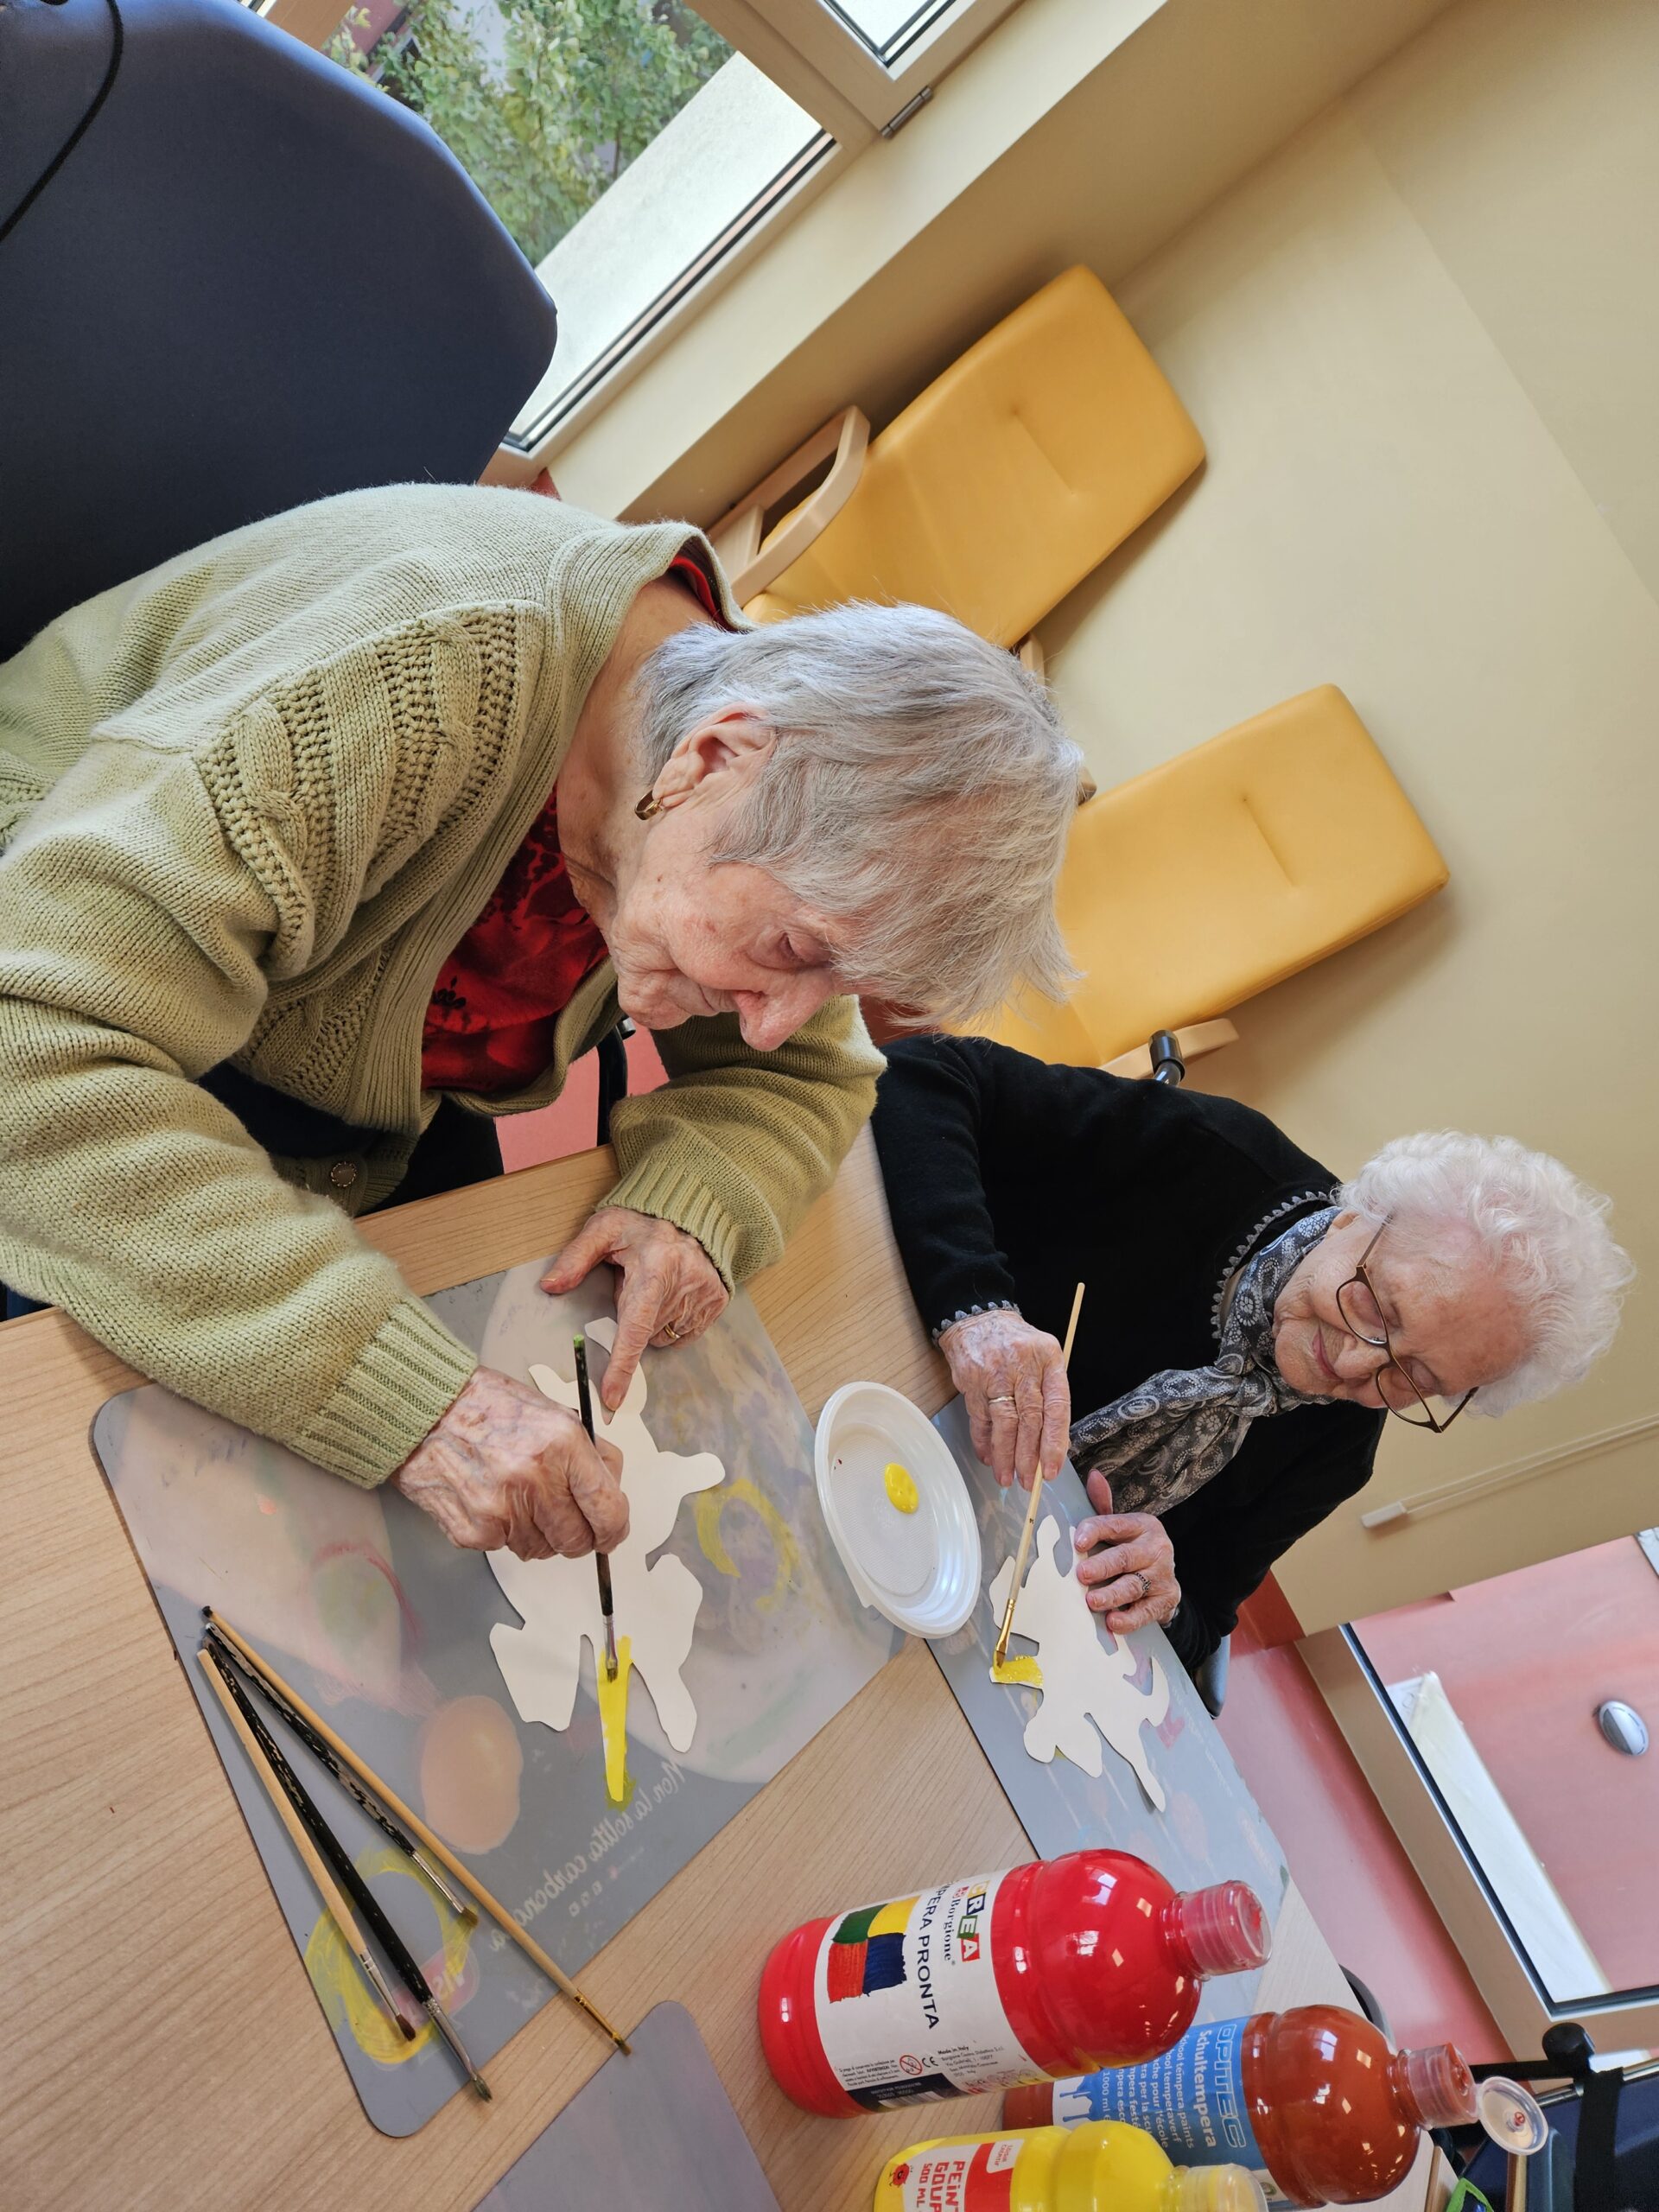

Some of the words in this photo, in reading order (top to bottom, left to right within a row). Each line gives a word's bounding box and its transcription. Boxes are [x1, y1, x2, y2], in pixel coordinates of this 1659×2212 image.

[919, 1884, 950, 1930] PERA
[957, 1880, 990, 1961] CREA
[917, 1936, 939, 2029] PRONTA
[1165, 2050, 1174, 2069] hool
[1139, 2082, 1147, 2099] per
[1150, 2082, 1160, 2107] pour
[1193, 2031, 1216, 2147] Schultempera
[1215, 2024, 1246, 2147] OPITEC
[1103, 2098, 1110, 2112] ml
[1117, 2101, 1126, 2122] esco
[1129, 2101, 1141, 2128] festé
[1141, 2102, 1149, 2112] la
[1163, 2071, 1181, 2142] temperaverf
[1178, 2112, 1192, 2147] paints
[919, 2164, 932, 2183] 500
[917, 2188, 925, 2208] ML
